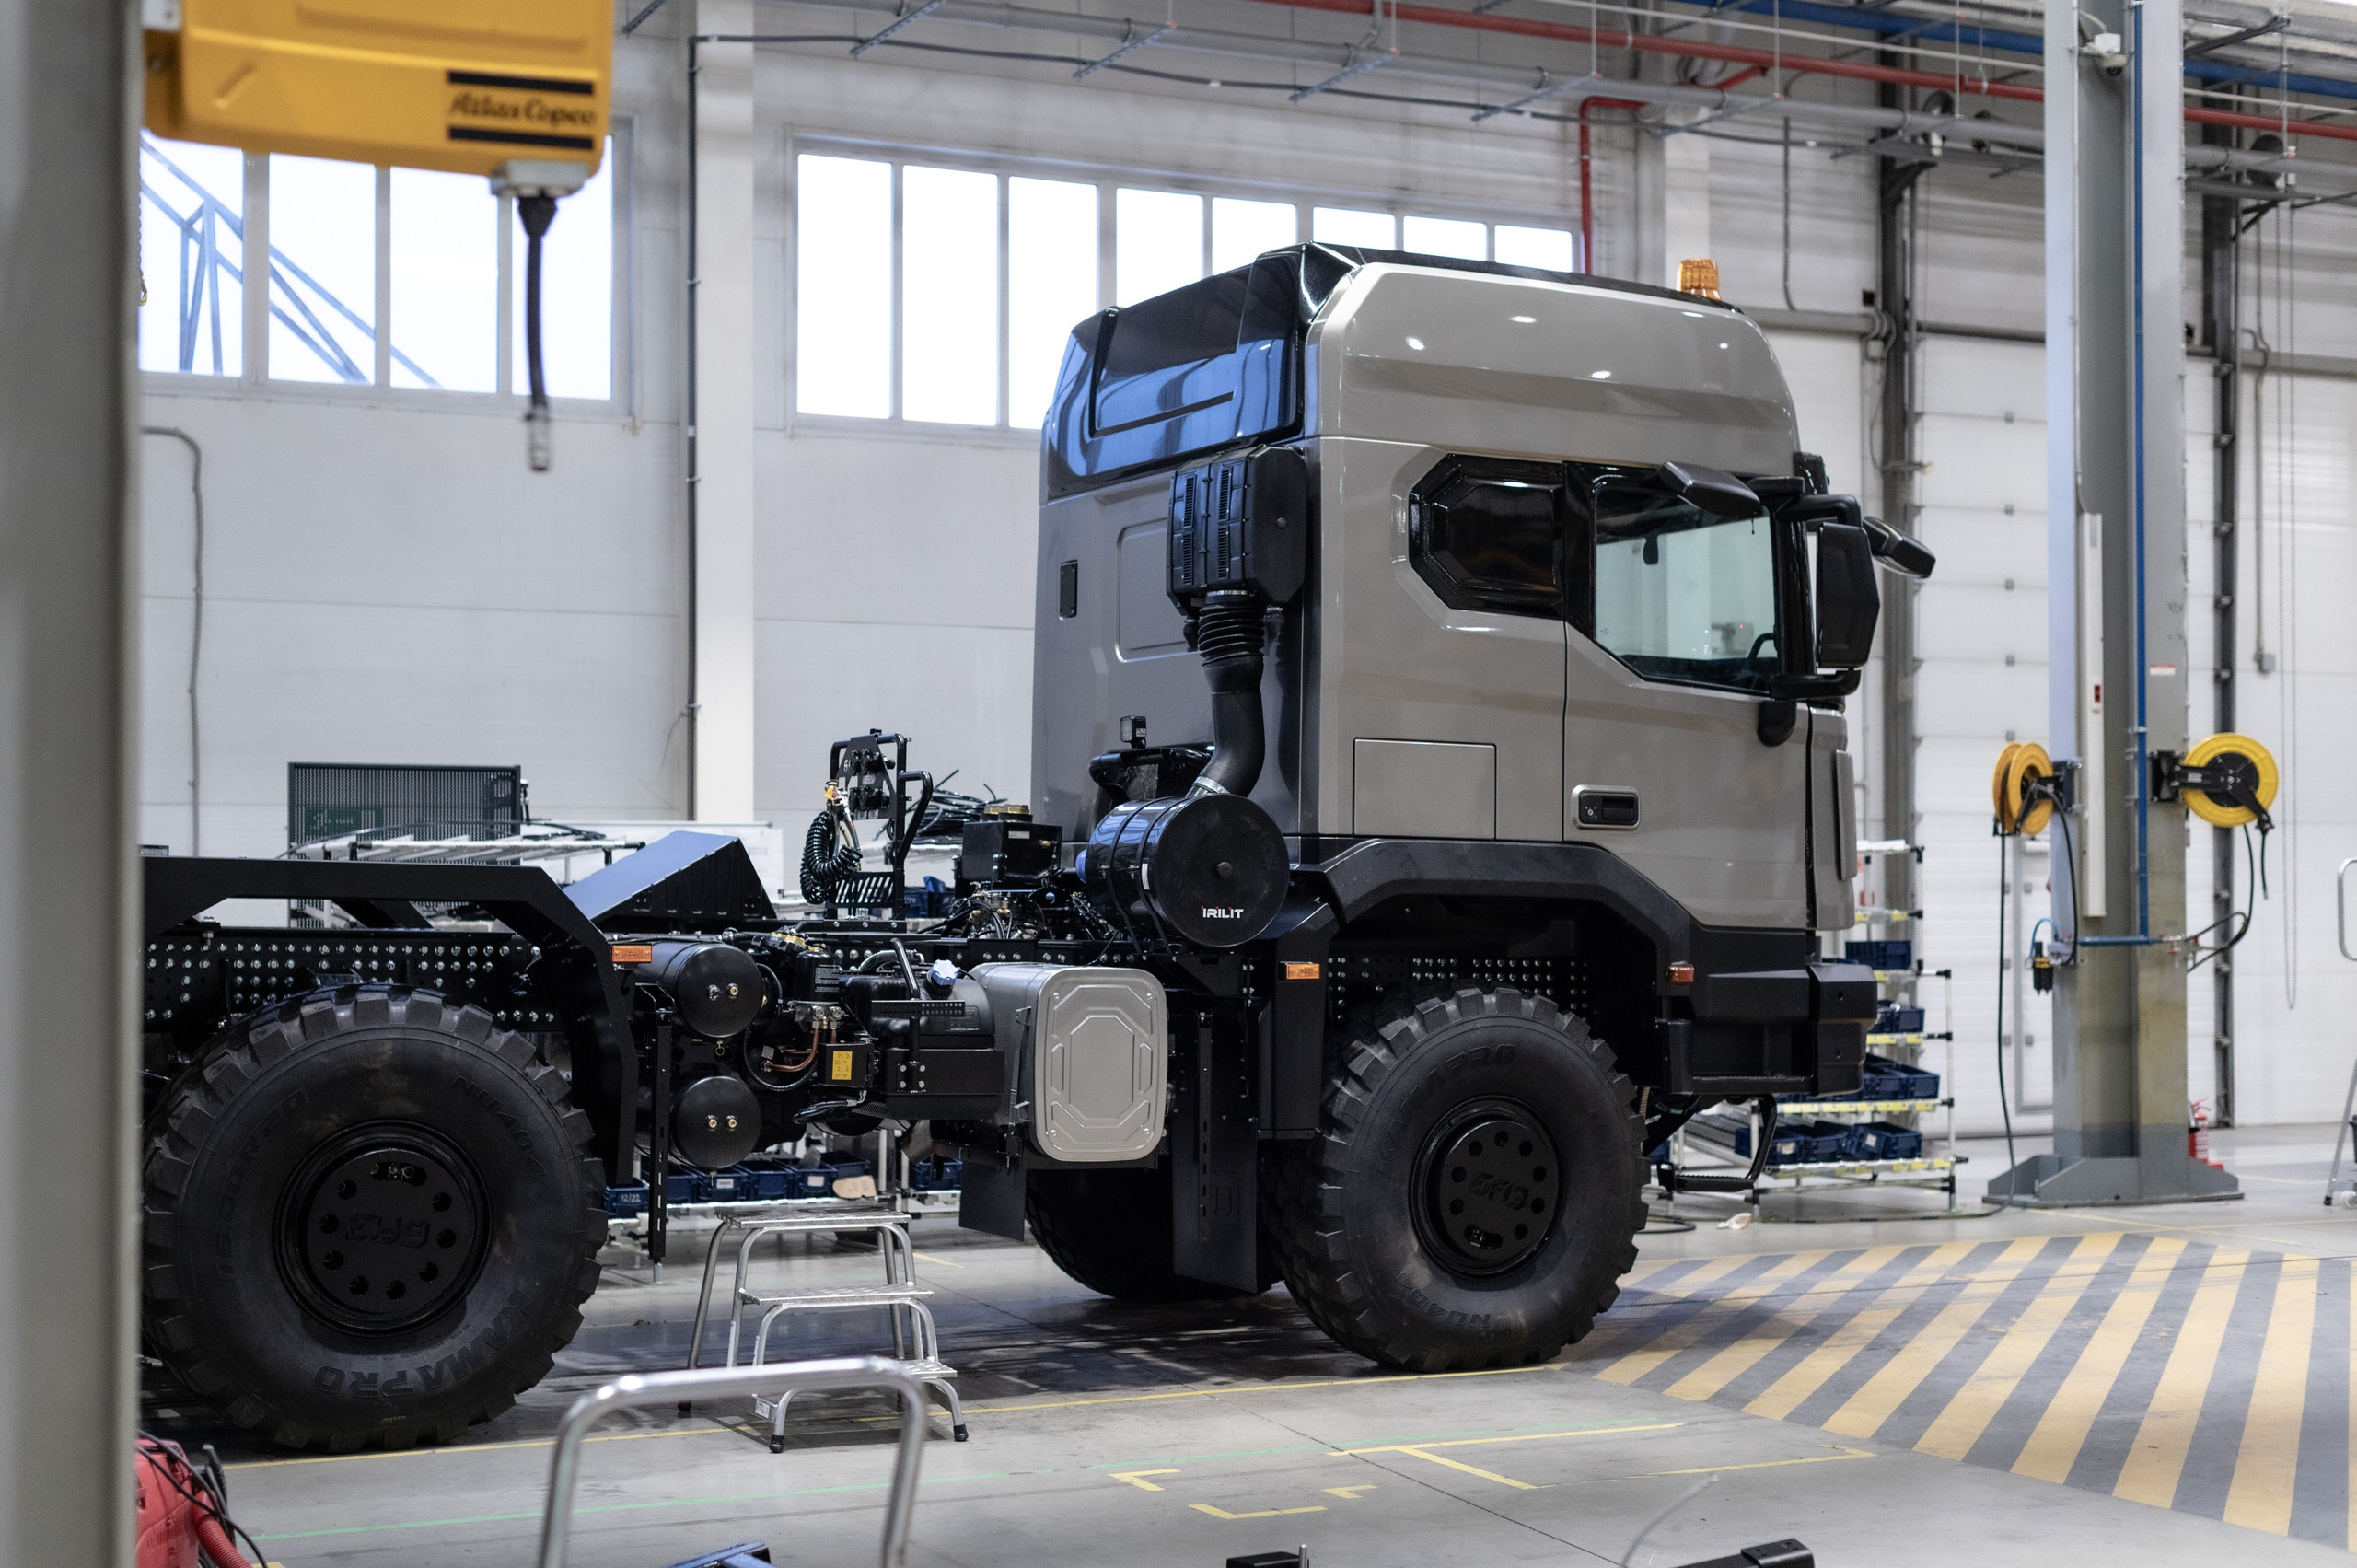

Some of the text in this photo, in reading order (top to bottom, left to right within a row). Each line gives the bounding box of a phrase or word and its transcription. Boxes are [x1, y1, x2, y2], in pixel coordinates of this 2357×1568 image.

[1200, 906, 1244, 919] IRILIT
[450, 1074, 547, 1178] NU404
[1395, 1272, 1492, 1329] NU404
[311, 1286, 536, 1399] KAMAPRO
